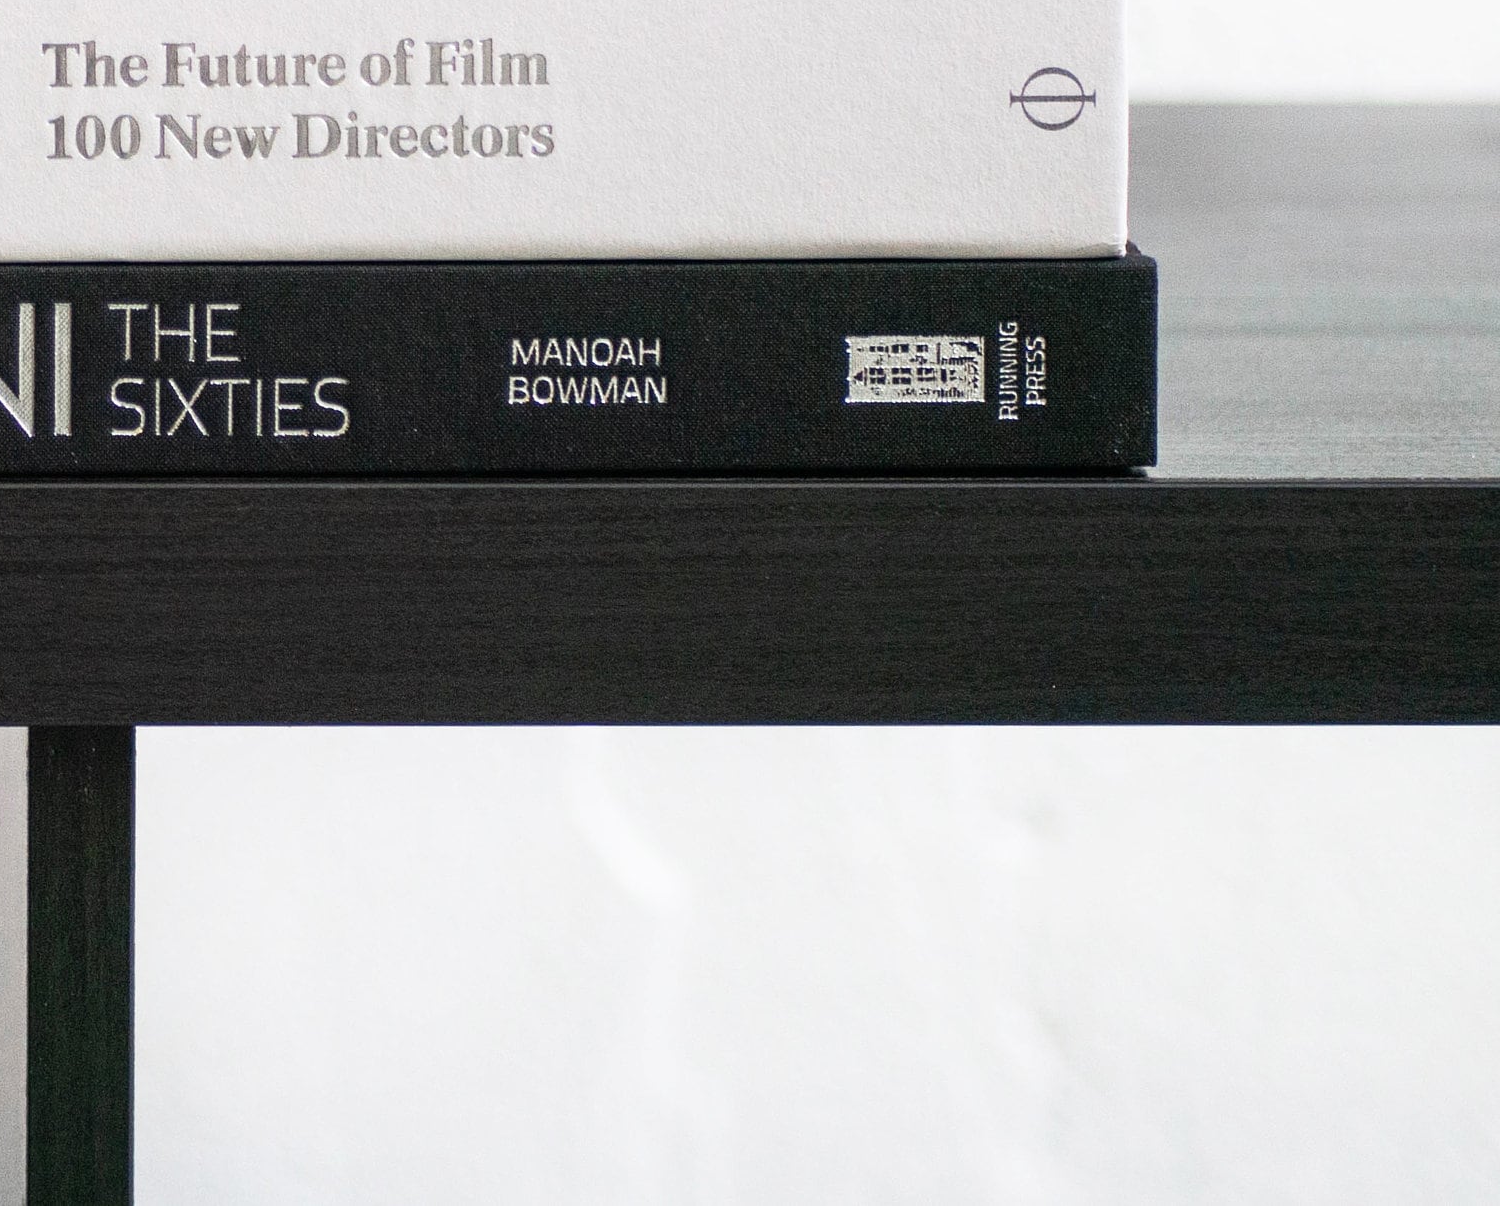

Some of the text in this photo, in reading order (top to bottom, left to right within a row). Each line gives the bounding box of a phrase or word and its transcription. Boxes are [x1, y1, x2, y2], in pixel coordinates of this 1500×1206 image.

[41, 38, 549, 87] The Future of Film
[47, 111, 555, 160] 100 New Directors
[107, 302, 240, 363] THE
[510, 337, 661, 367] MANOAH
[508, 375, 667, 406] BOWMAN
[998, 321, 1019, 421] RUNNING
[1025, 336, 1047, 406] PRESS
[109, 376, 350, 438] SIXTIES
